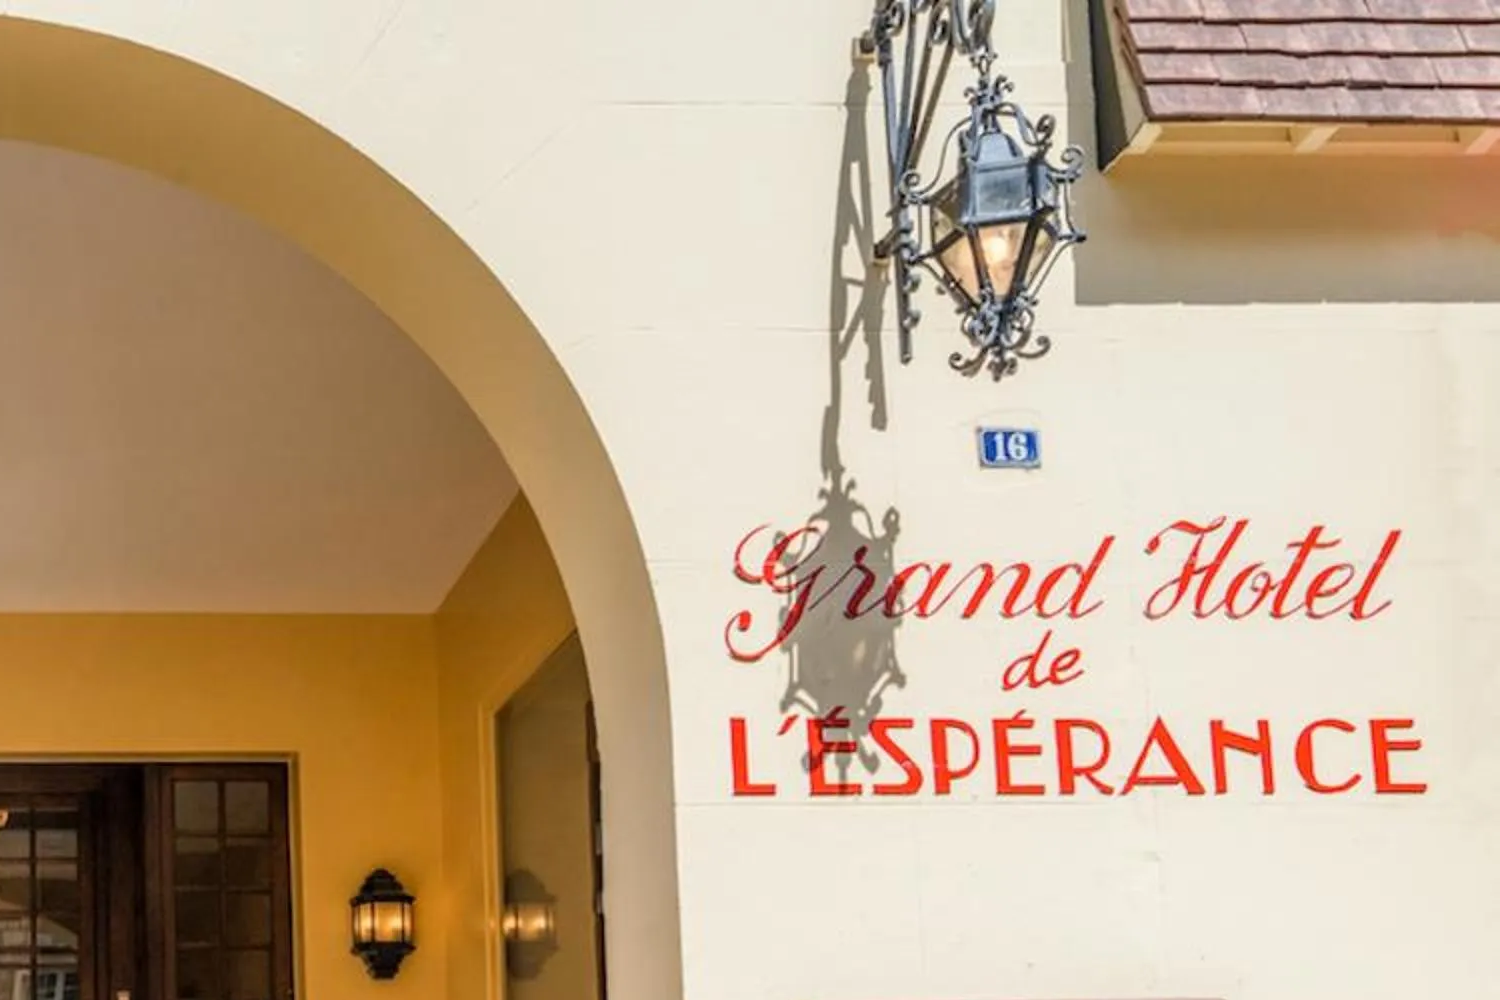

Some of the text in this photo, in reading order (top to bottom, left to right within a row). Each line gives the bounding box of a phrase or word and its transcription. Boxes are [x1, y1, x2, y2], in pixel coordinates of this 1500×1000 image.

[994, 431, 1028, 461] 16
[725, 515, 1402, 662] Grand Hotel
[1000, 629, 1084, 691] de
